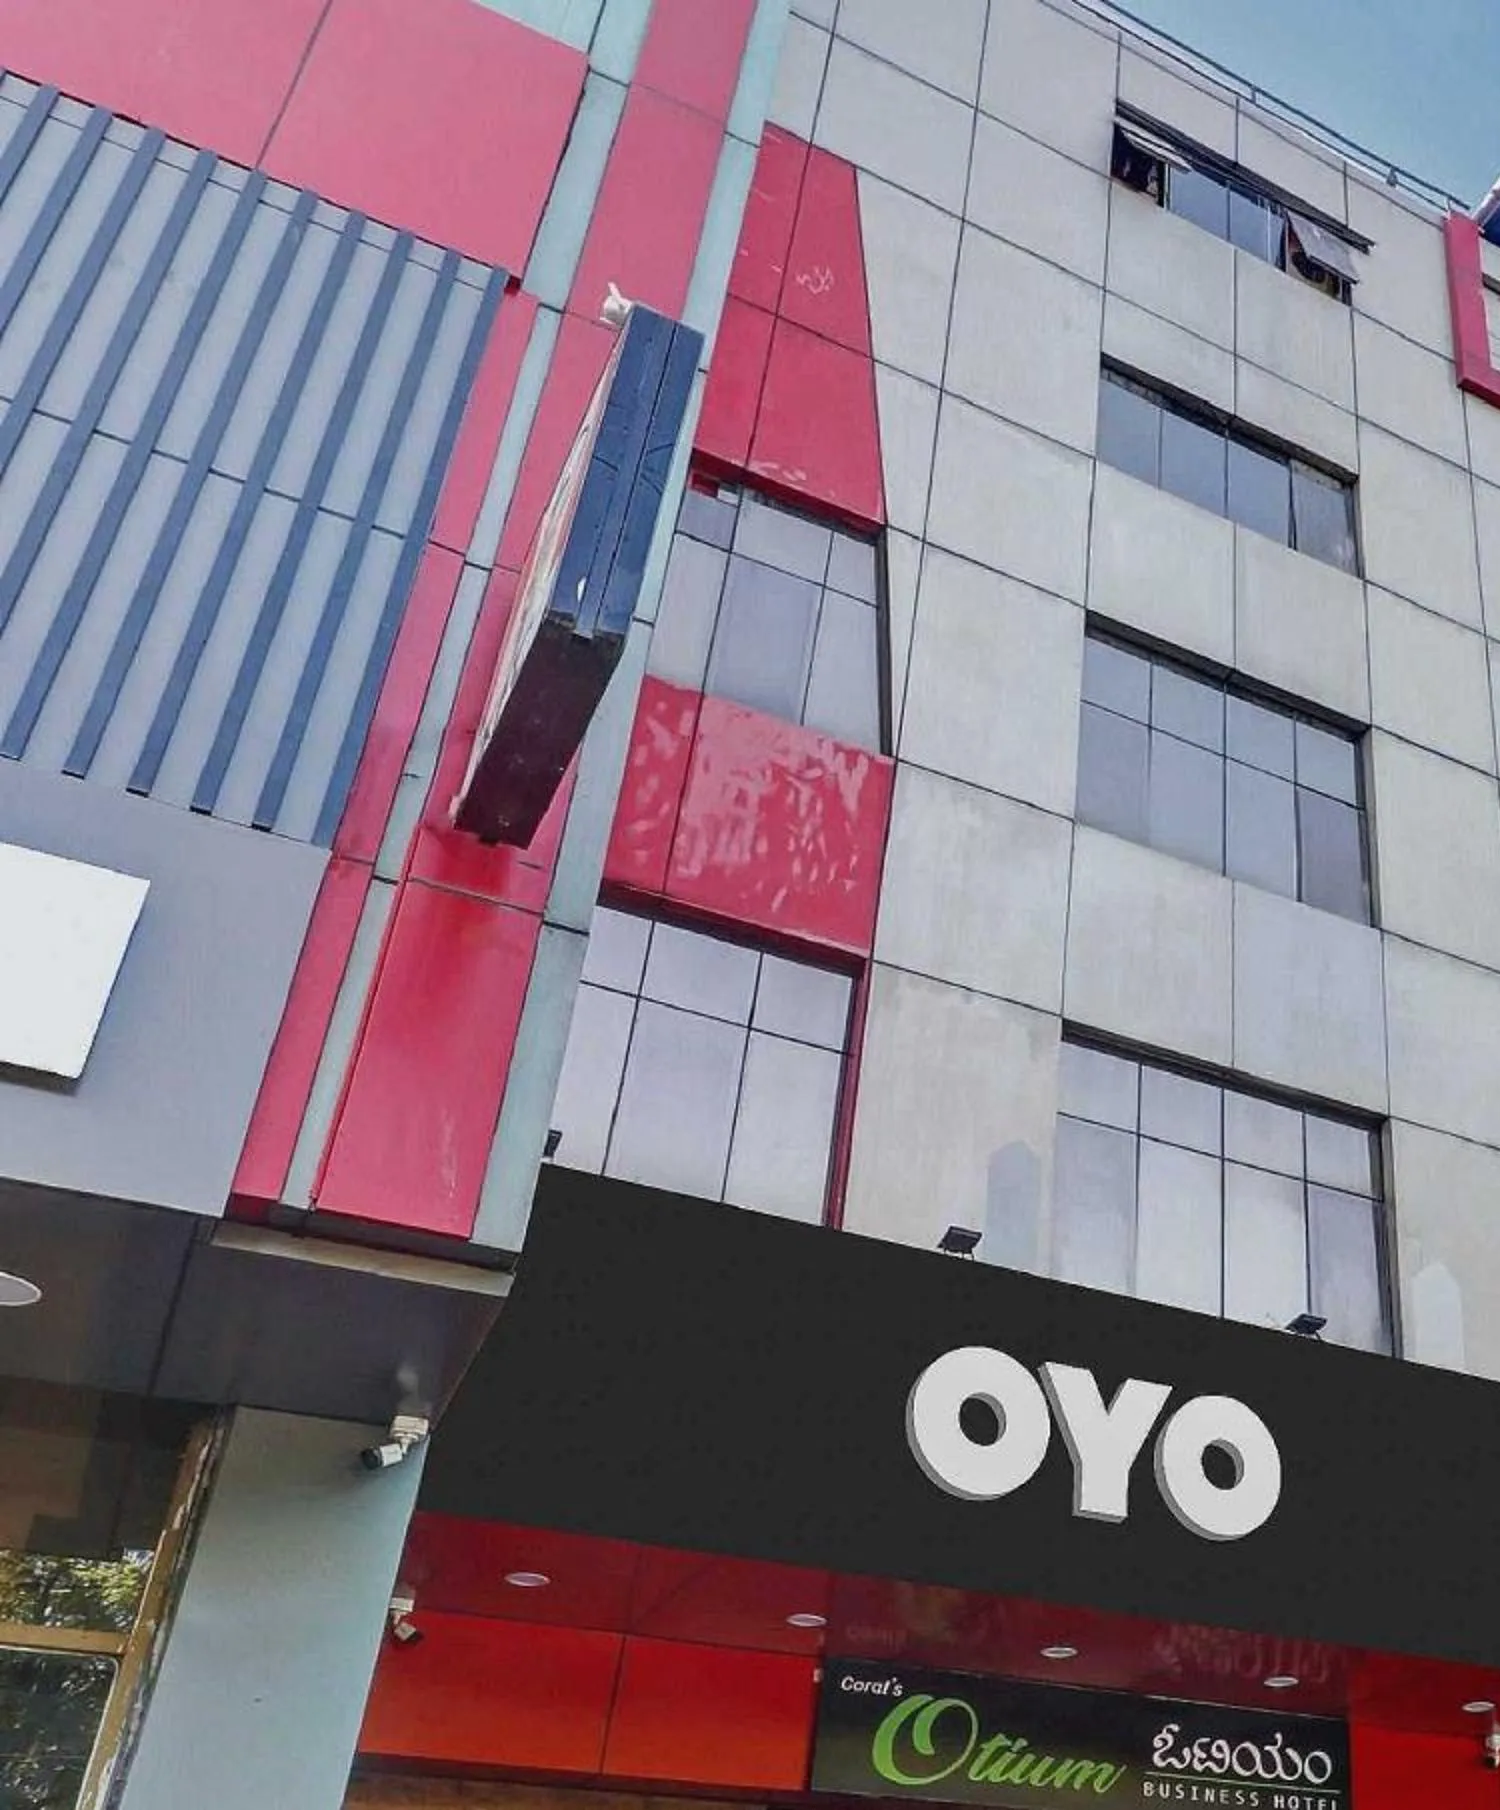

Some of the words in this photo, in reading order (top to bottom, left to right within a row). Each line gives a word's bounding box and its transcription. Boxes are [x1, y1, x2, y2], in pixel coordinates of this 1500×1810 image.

[906, 1346, 1281, 1541] OYO
[841, 1676, 903, 1697] Coral's
[872, 1695, 1126, 1793] Otium
[1143, 1781, 1260, 1807] BUSINESS
